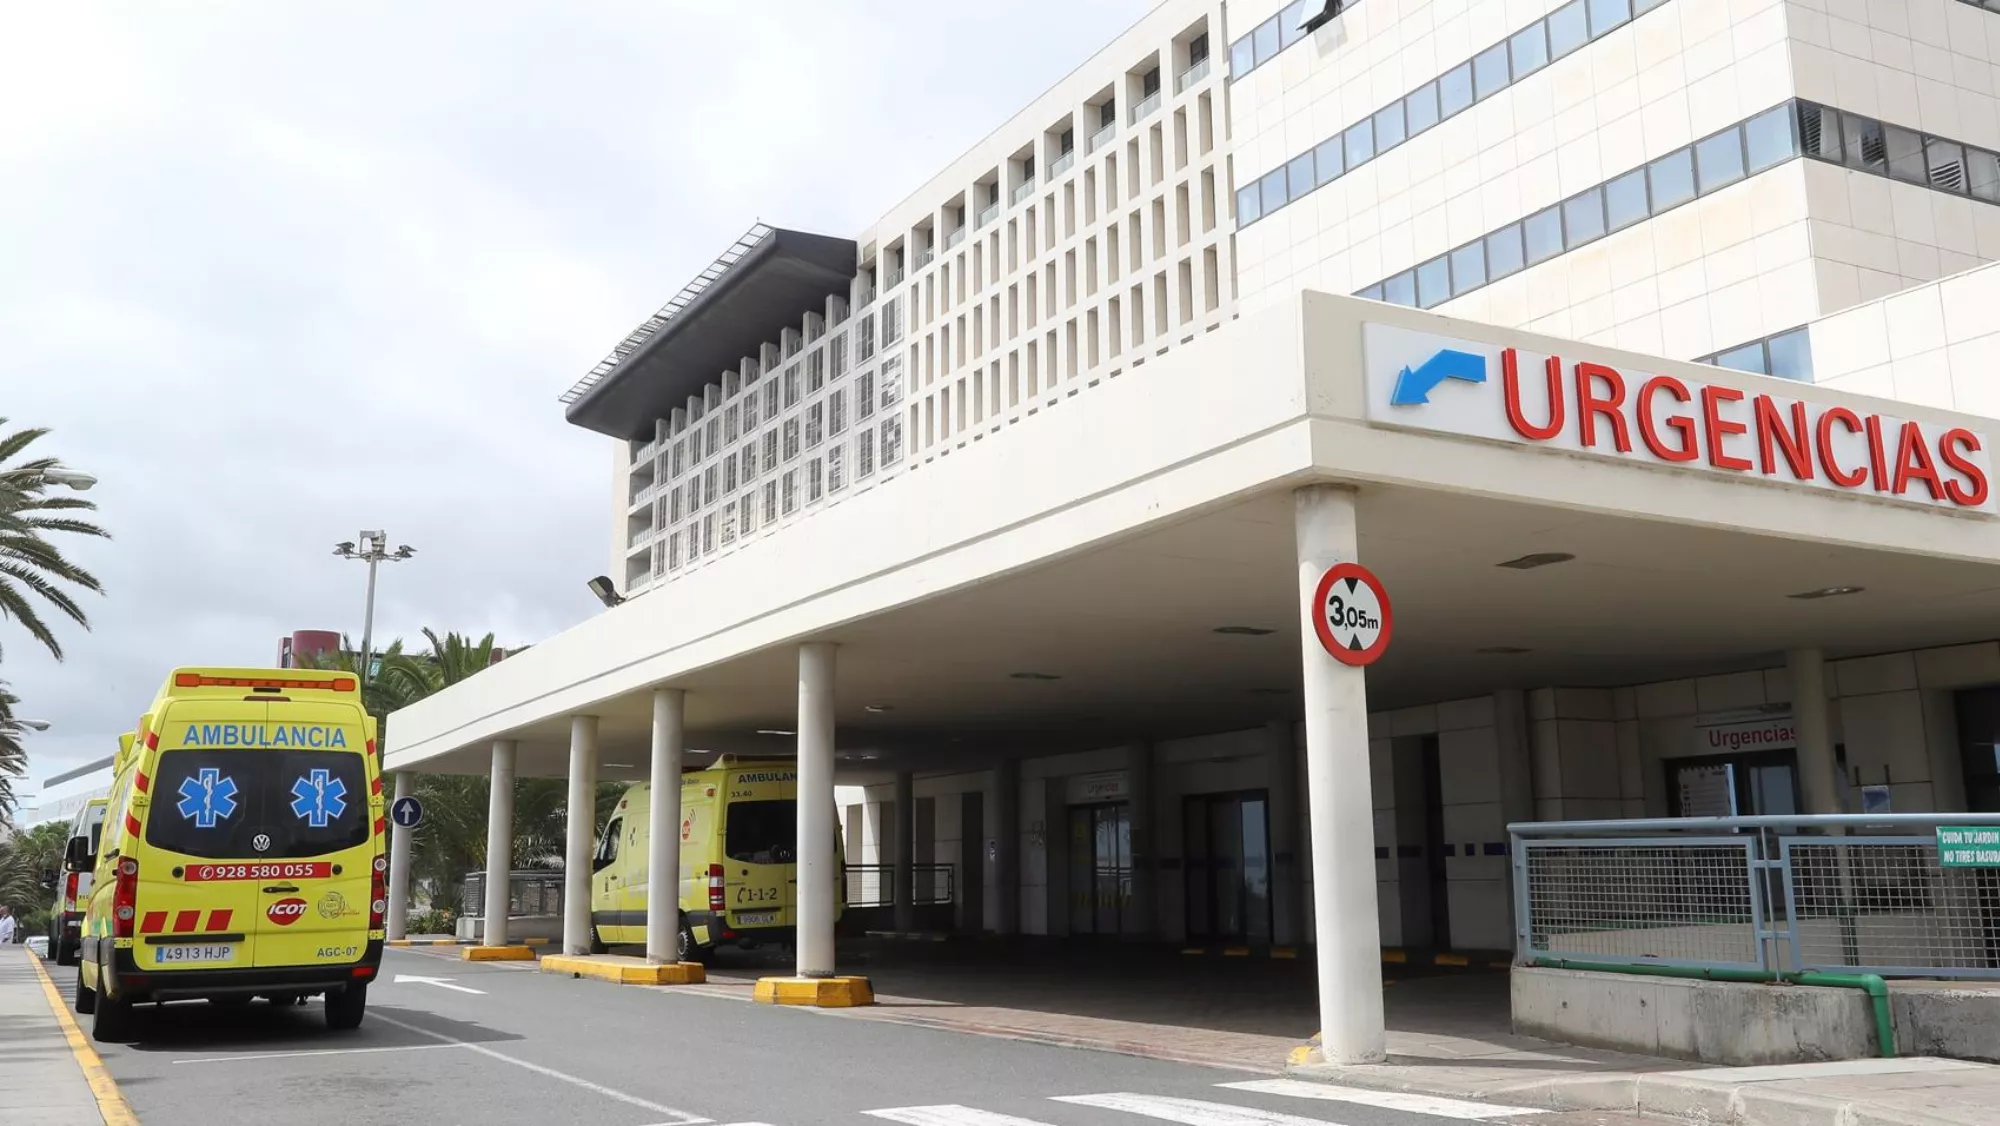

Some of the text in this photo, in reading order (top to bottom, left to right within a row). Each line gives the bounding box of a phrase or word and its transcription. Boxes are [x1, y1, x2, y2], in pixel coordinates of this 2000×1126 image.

[1501, 347, 1989, 507] URGENCIAS
[1328, 595, 1378, 630] 3,05m
[182, 724, 347, 748] AMBULANCIA
[216, 864, 314, 878] 928 580 055
[747, 887, 777, 901] 1-1-2
[268, 903, 308, 915] ICOT
[165, 948, 230, 960] 4913 HJP
[317, 947, 358, 957] AGC-07
